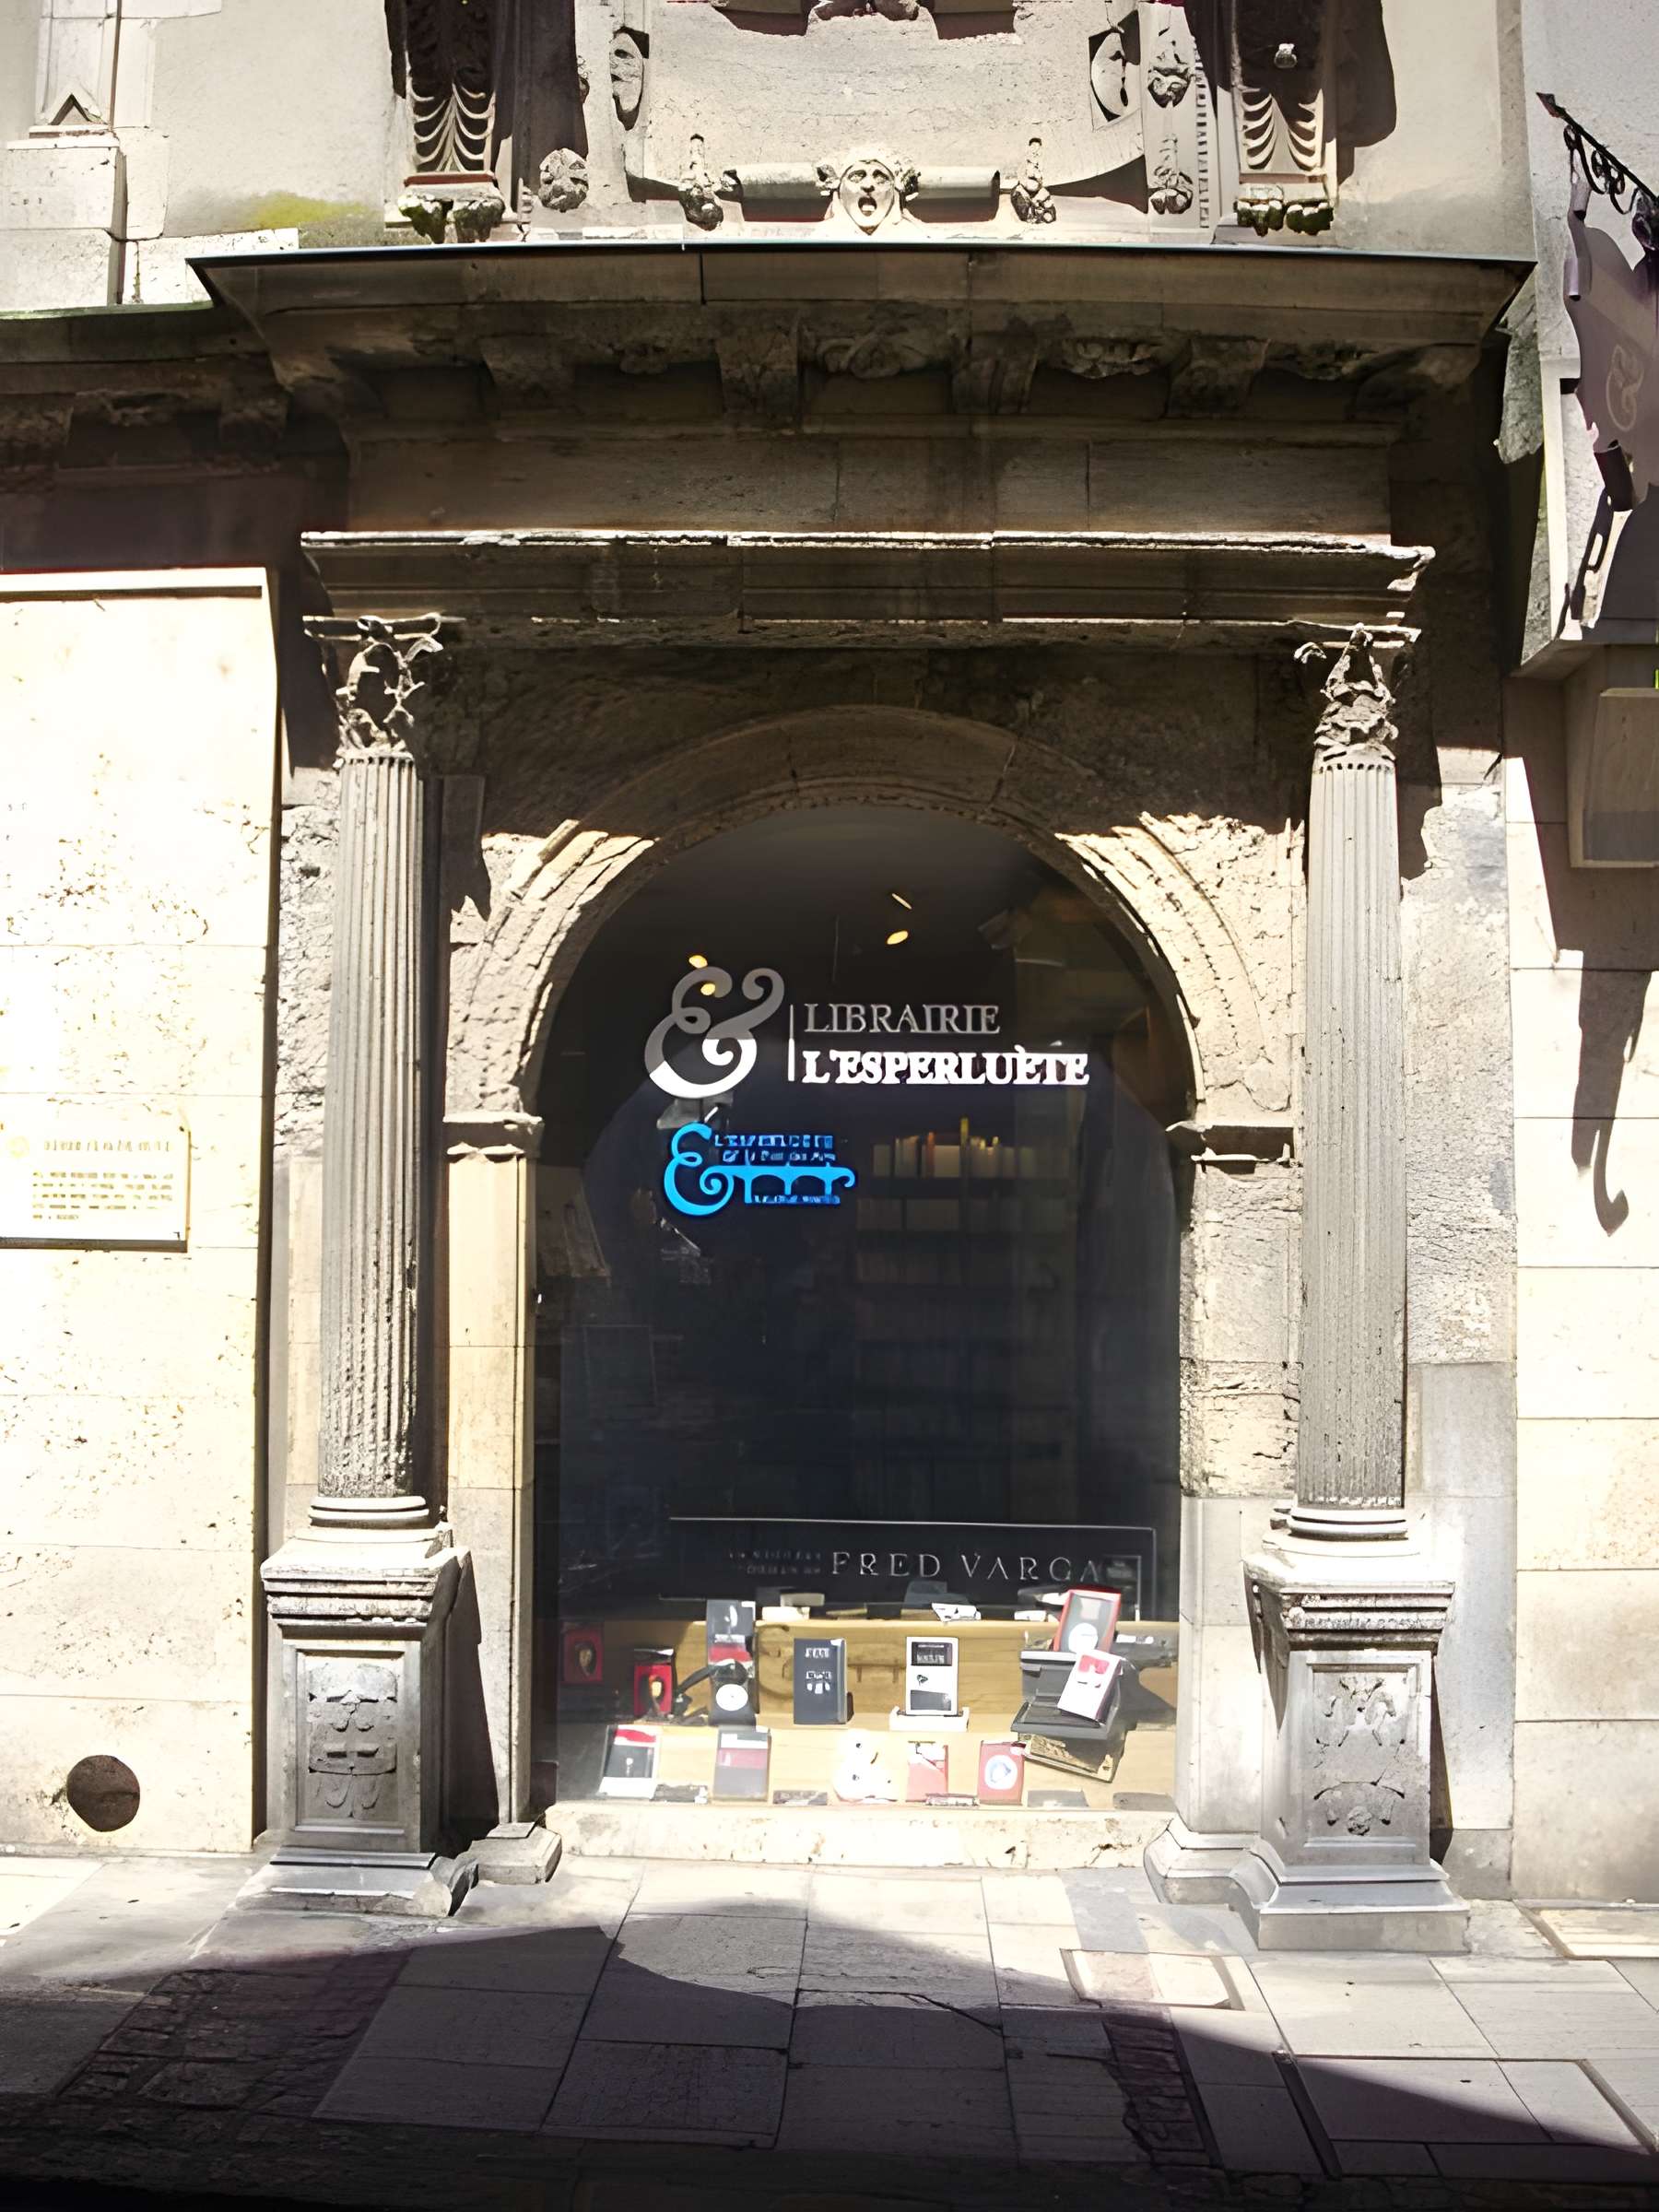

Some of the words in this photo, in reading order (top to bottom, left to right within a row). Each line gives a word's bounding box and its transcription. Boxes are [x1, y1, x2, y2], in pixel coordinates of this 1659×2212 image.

[804, 1003, 1001, 1034] LIBRAIRIE
[832, 1551, 941, 1577] FRED
[960, 1554, 1100, 1583] VARGA
